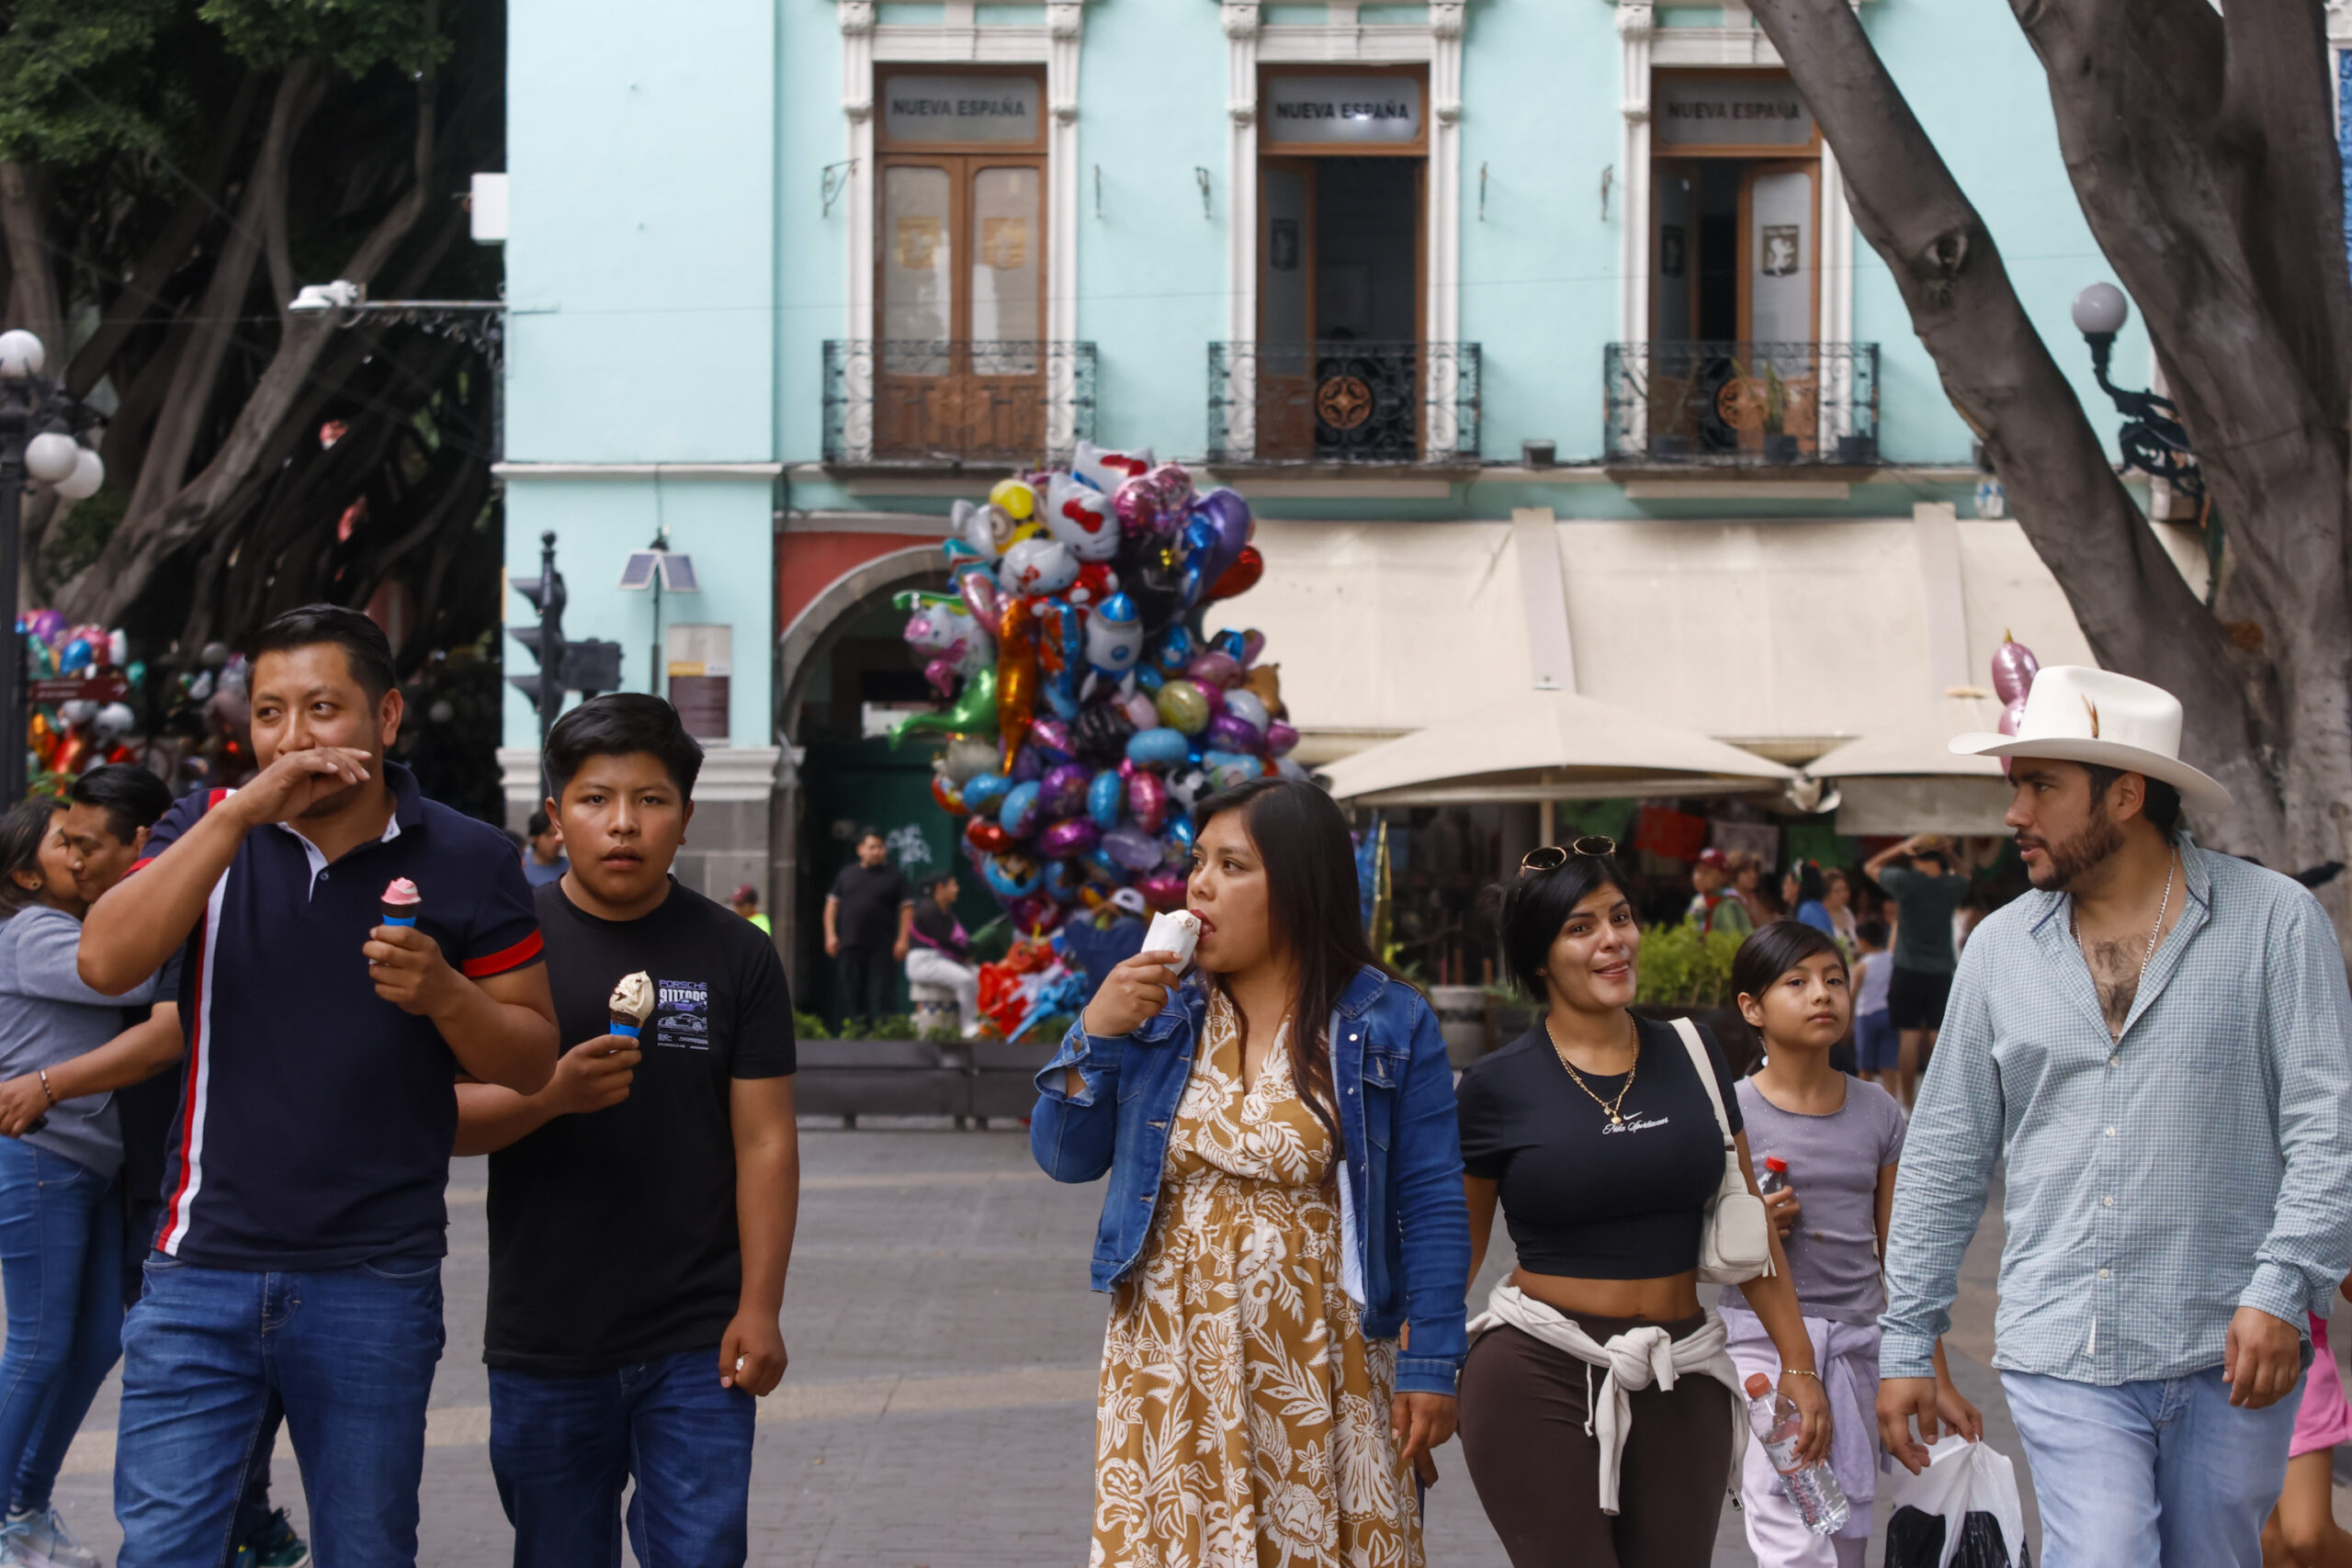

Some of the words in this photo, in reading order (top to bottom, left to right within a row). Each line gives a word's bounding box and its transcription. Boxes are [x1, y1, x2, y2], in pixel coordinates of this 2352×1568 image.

[892, 99, 952, 116] NUEVA
[957, 96, 1025, 116] ESPAÑA
[1277, 103, 1335, 118] NUEVA
[1341, 100, 1408, 118] ESPAÑA
[1668, 103, 1727, 118] NUEVA
[1733, 100, 1800, 118] ESPAÑA
[659, 979, 707, 990] PORSCHE
[1602, 1122, 1626, 1135] Nike
